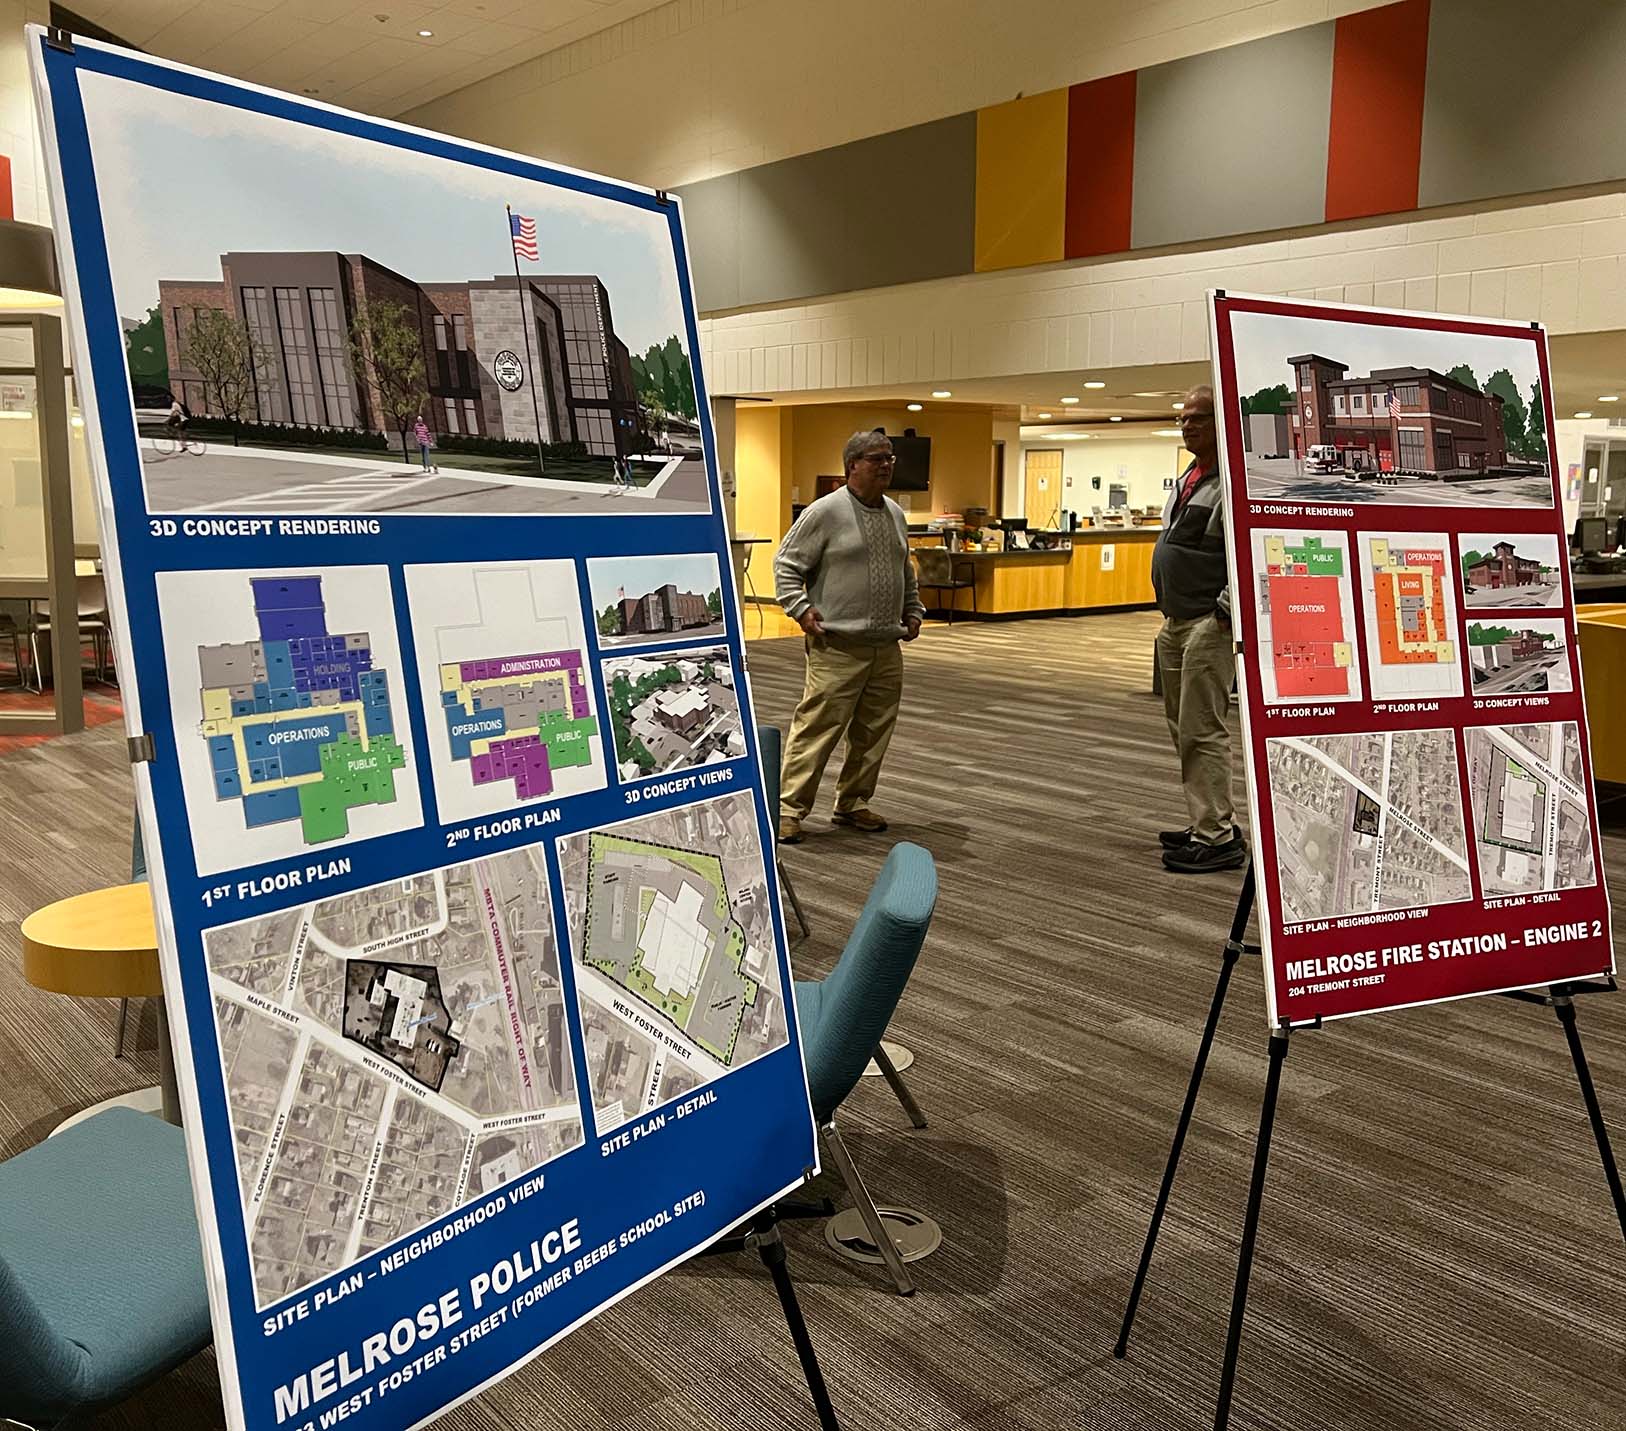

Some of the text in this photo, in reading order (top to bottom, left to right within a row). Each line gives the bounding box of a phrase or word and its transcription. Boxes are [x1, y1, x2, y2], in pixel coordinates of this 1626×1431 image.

[592, 284, 604, 331] DEPARTMENT
[1250, 505, 1354, 517] 3D CONCEPT RENDERING
[150, 520, 381, 536] 3D CONCEPT RENDERING
[1312, 554, 1333, 562] PUBLIC
[1288, 605, 1325, 613] OPERATIONS
[313, 662, 351, 676] HOLDING
[500, 657, 561, 673] ADMINISTRATION
[1266, 707, 1335, 718] 1ST FLOOR PLAN
[1373, 702, 1438, 713] 2ND FLOOR PLAN
[1474, 697, 1550, 708] 3D CONCEPT VIEWS
[268, 726, 330, 745] OPERATIONS
[452, 719, 502, 736] OPERATIONS
[556, 730, 582, 742] PUBLIC
[348, 758, 378, 771] PUBLIC
[1535, 762, 1578, 797] MELROSE STREET
[624, 768, 733, 804] 3D CONCEPT VIEWS
[446, 808, 561, 848] 2ND FLOOR PLAN
[1389, 807, 1433, 843] MELROSE STREET
[202, 858, 351, 908] 1ST FLOOR PLAN
[1484, 900, 1502, 910] SITE
[1504, 897, 1526, 907] PLAN
[1533, 893, 1560, 904] DETAIL
[1283, 925, 1303, 935] SITE
[1306, 921, 1329, 932] PLAN
[1337, 912, 1406, 928] NEIGHBORHOOD
[1407, 909, 1428, 919] VIEW
[288, 921, 309, 991] VINTON STREET
[363, 928, 429, 953] SOUTH HIGH STREET
[1286, 951, 1377, 981] MELROSE
[1382, 944, 1424, 967] FIRE
[1428, 933, 1506, 959] STATION
[1524, 922, 1588, 947] ENGINE
[1592, 920, 1602, 937] 2
[484, 888, 531, 1088] MBTA COMMUTER RAIL RIGHT OF WAY
[1288, 974, 1385, 997] 204 TREMONT STREET
[247, 995, 299, 1024] MAPLE STREET
[612, 1000, 692, 1060] WEST FOSTER STREET
[363, 1056, 426, 1098] WEST FOSTER STREET
[648, 1062, 661, 1106] STREET
[500, 1117, 523, 1126] FOSTER
[524, 1114, 546, 1122] STREET
[601, 1134, 630, 1157] SITE
[633, 1114, 665, 1140] PLAN
[676, 1090, 718, 1120] DETAIL
[254, 1114, 285, 1202] FLORENCE STREET
[455, 1134, 476, 1207] COTTAGE STREET
[358, 1142, 382, 1220] TRENTON STREET
[263, 1302, 311, 1337] SITE
[314, 1276, 365, 1310] PLAN
[380, 1200, 506, 1277] NEIGHBORHOOD
[508, 1175, 546, 1204] VIEW
[272, 1218, 582, 1424] MELROSE POLICE
[320, 1387, 374, 1430] WEST
[378, 1348, 446, 1399] FOSTER
[450, 1308, 509, 1355] STREET
[512, 1266, 572, 1320] (FORMER
[574, 1240, 617, 1276] BEEBE
[620, 1214, 673, 1248] SCHOOL
[674, 1190, 706, 1220] SITE)
